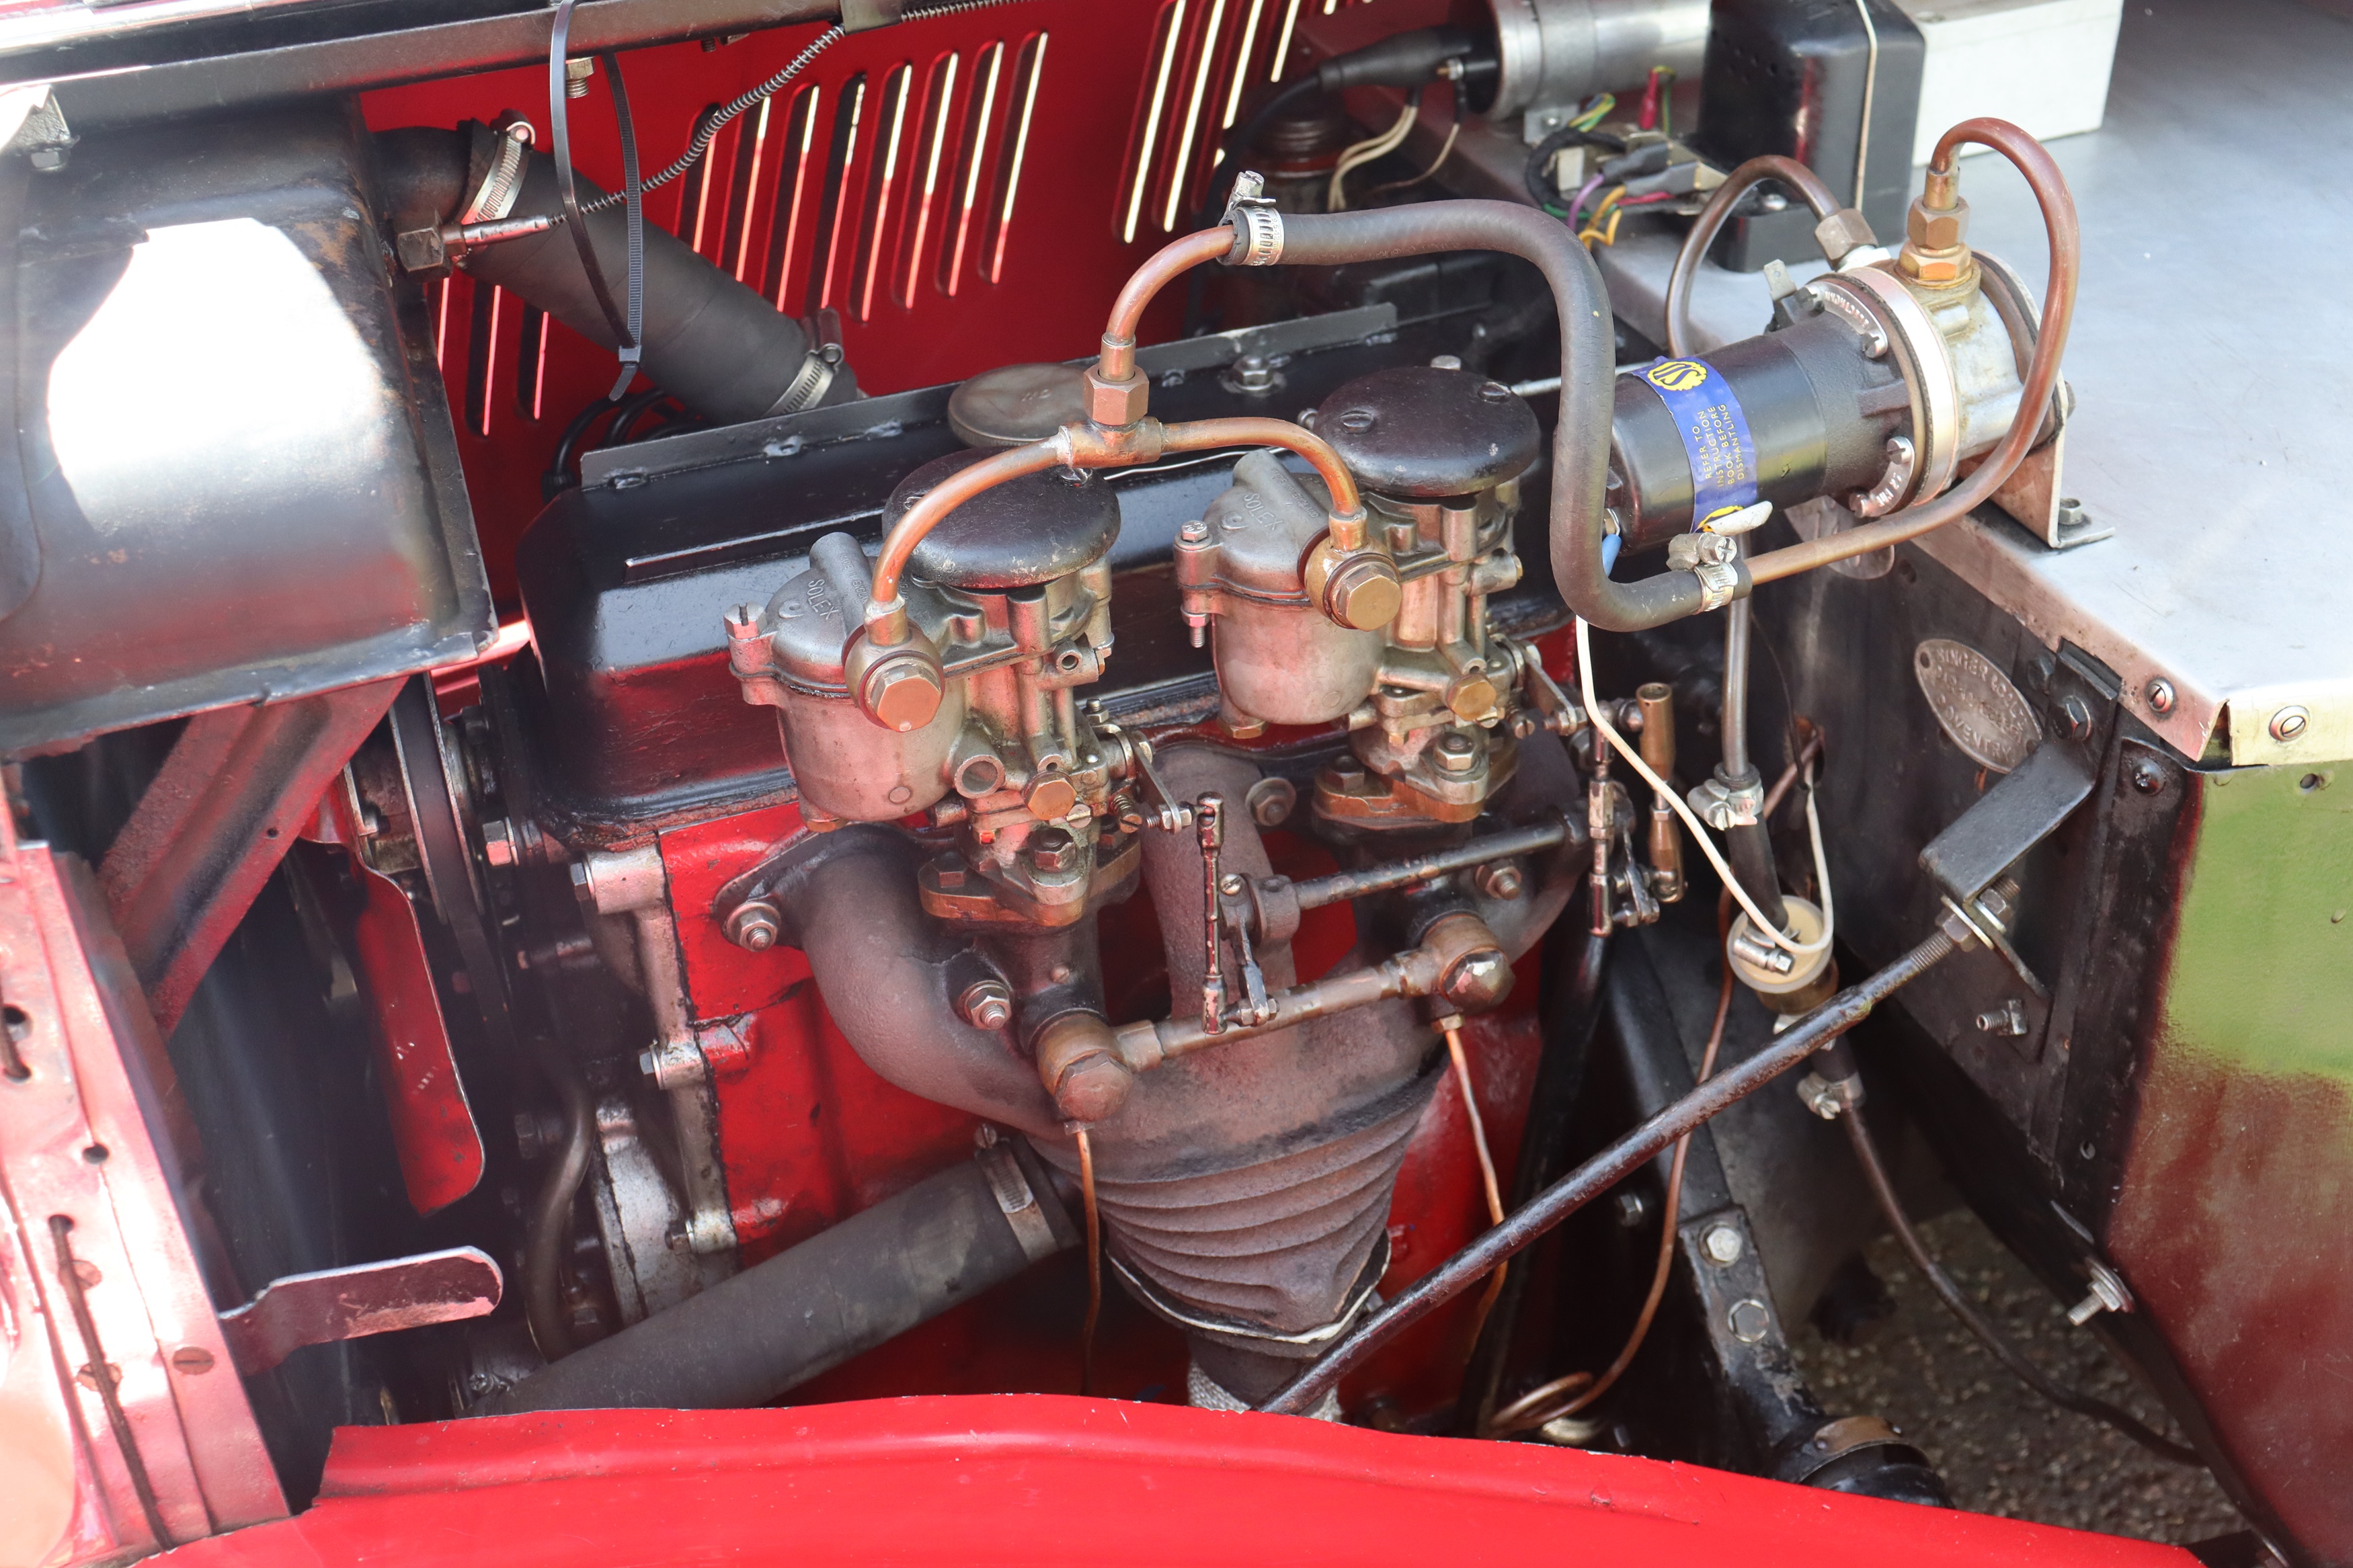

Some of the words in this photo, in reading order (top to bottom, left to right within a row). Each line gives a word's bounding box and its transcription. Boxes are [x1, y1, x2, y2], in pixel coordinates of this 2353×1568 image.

[1693, 425, 1702, 442] TO
[1708, 406, 1729, 447] BEFORE
[1718, 404, 1745, 480] DISMANTLING
[1698, 411, 1726, 487] INSTRUCTION
[1699, 447, 1712, 479] REFER
[1724, 453, 1735, 485] BOOK
[1243, 493, 1285, 531] SOLEX
[1291, 492, 1319, 518] ENGLAND
[838, 552, 854, 570] MADE
[852, 580, 869, 604] ENGLAN
[806, 579, 840, 620] SOLEX
[1936, 649, 1989, 682] SINGER
